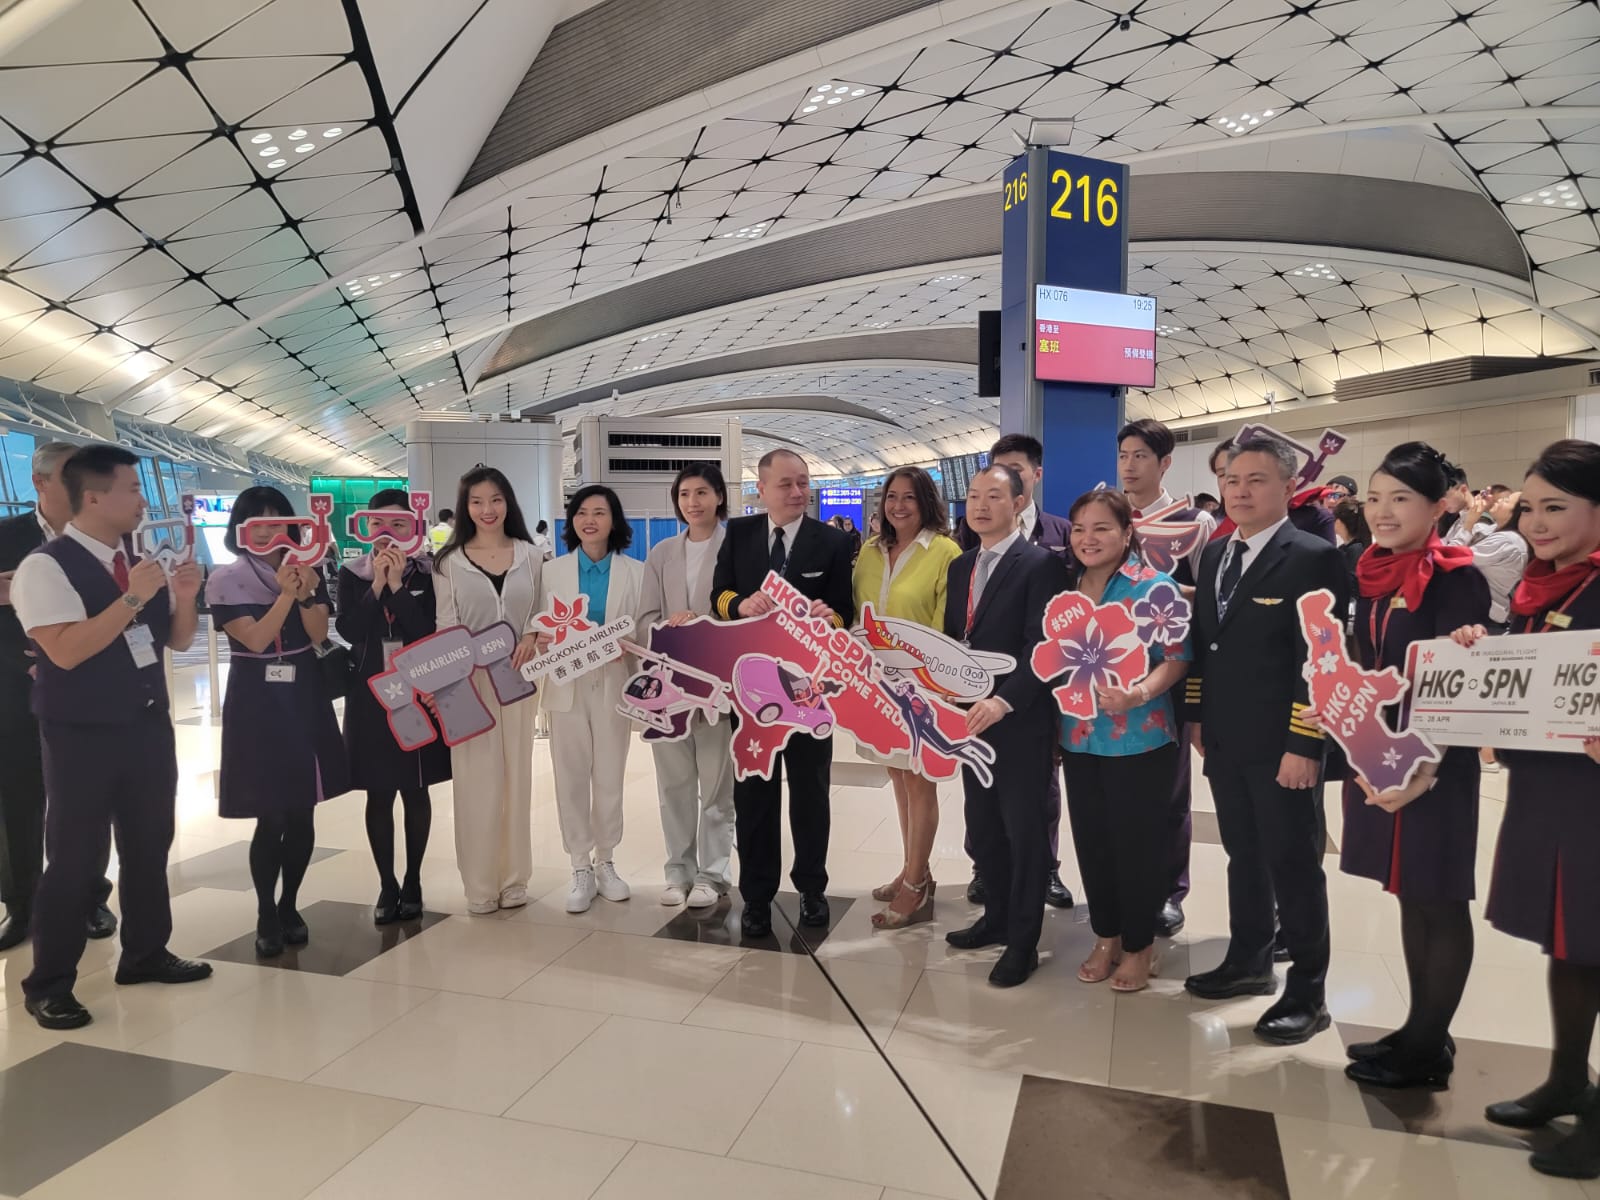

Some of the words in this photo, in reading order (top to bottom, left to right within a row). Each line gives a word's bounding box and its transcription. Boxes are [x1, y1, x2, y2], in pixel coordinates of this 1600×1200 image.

[1004, 172, 1028, 211] 216
[1050, 168, 1118, 227] 216
[1039, 288, 1052, 300] HX
[1053, 290, 1068, 302] 076
[763, 573, 809, 618] HKG
[1051, 602, 1086, 633] #SPN
[409, 646, 471, 679] #HKAIRLINES
[480, 637, 506, 655] #SPN
[526, 640, 587, 675] HONGKONG
[589, 619, 630, 645] AIRLINES
[554, 642, 616, 679] 香港航空
[831, 661, 873, 699] COME
[1417, 668, 1465, 698] HKG
[1479, 667, 1533, 699] SPN
[1553, 662, 1598, 687] HKG
[1322, 681, 1351, 726] HKG
[1349, 679, 1378, 722] SPN
[1499, 728, 1511, 737] HX
